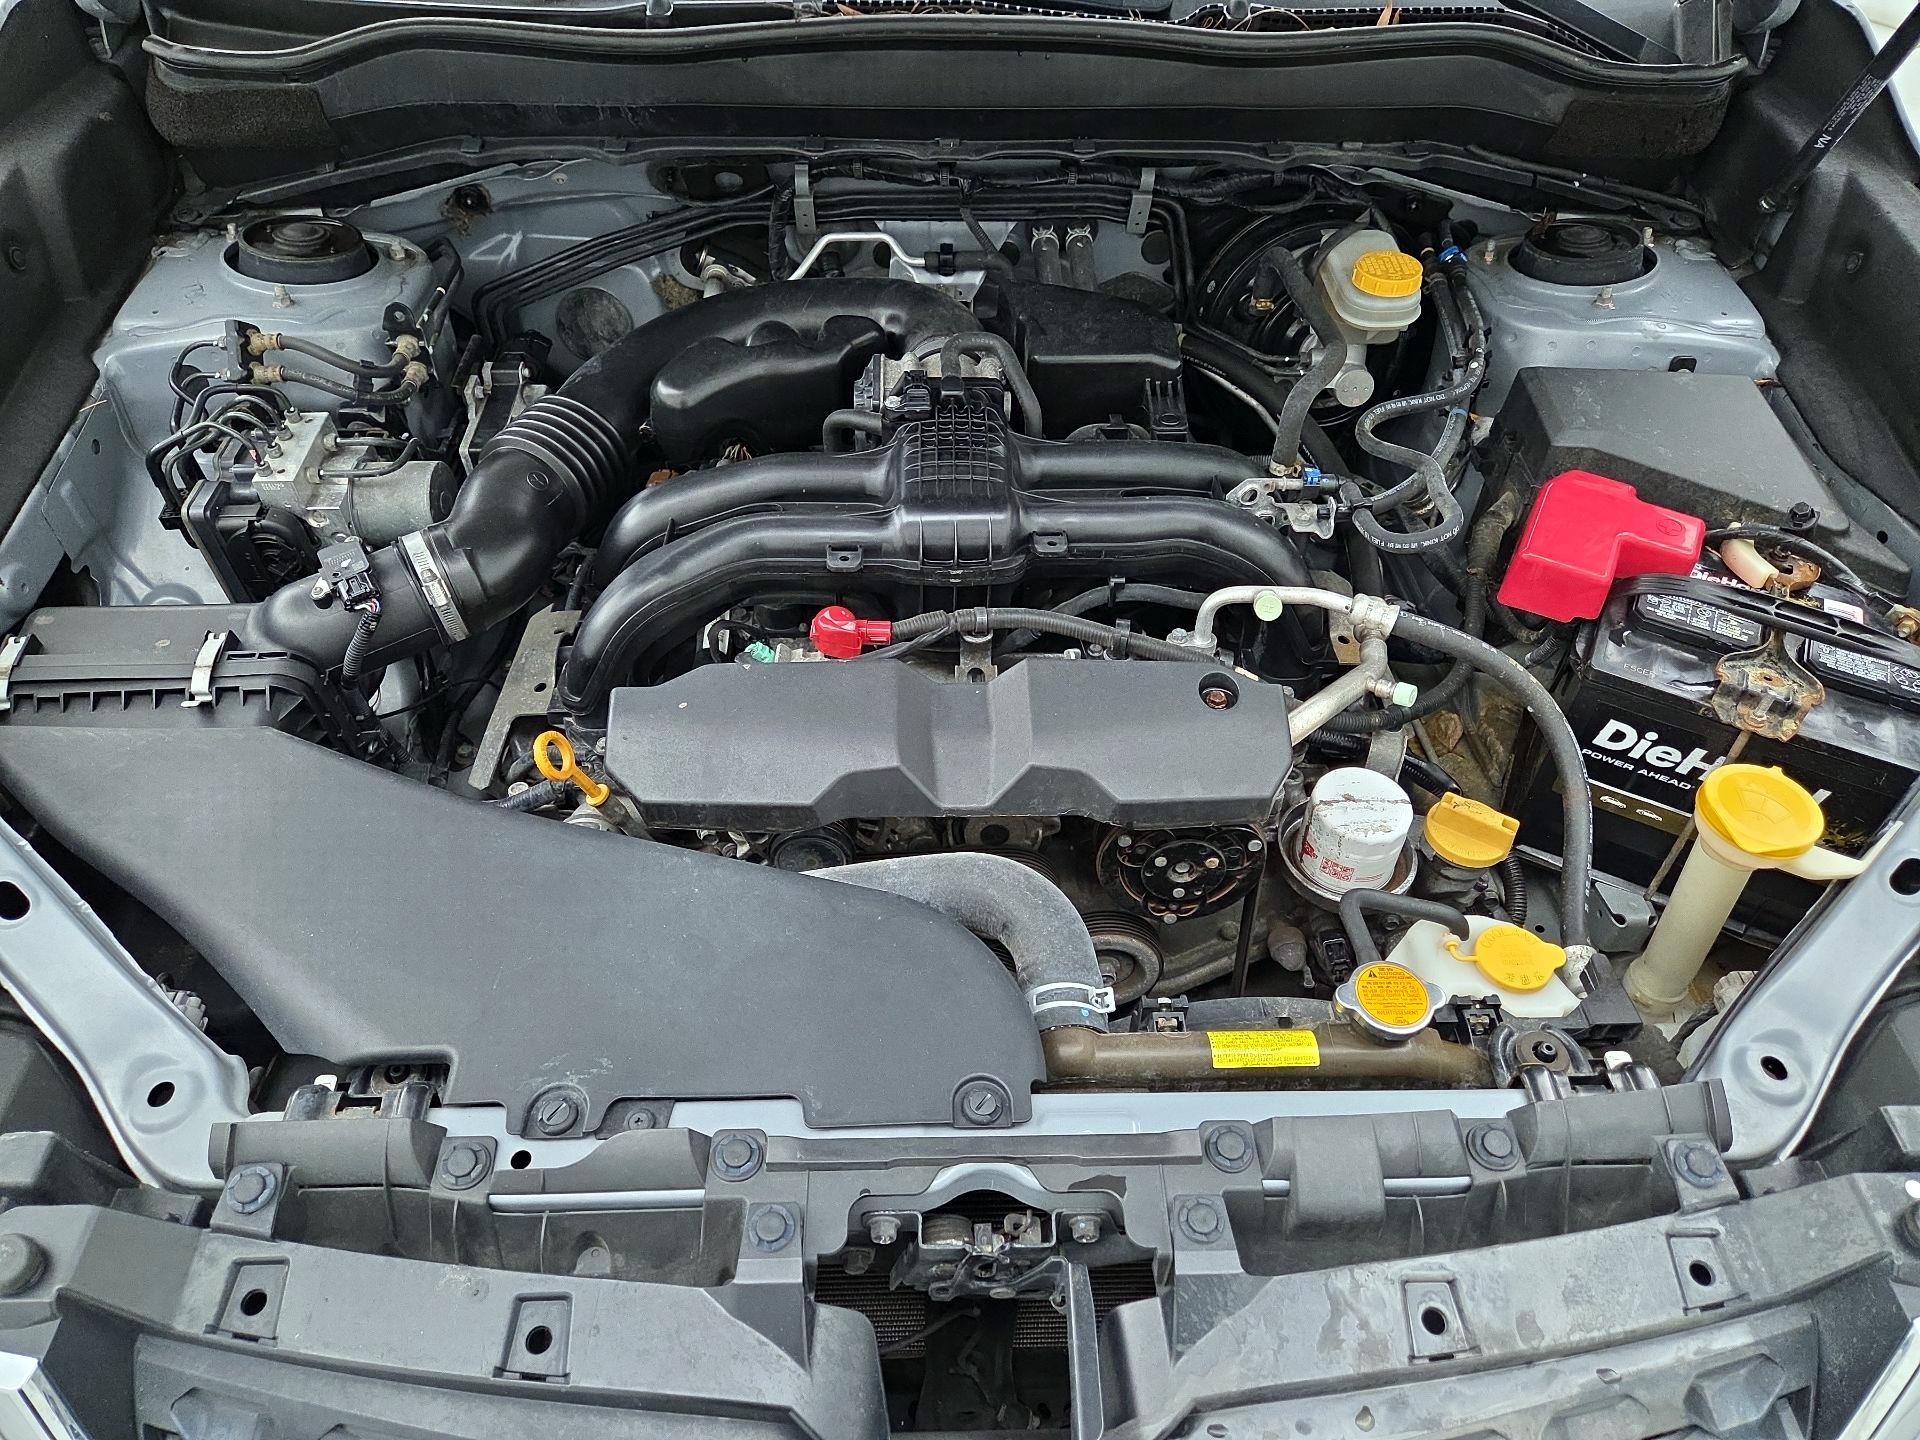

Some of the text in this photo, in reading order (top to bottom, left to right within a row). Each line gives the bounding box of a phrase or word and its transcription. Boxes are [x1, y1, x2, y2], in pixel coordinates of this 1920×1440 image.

[1423, 396, 1435, 404] NOT
[1435, 393, 1446, 401] DO
[1452, 525, 1460, 535] DO
[1439, 530, 1452, 541] NOT
[1582, 749, 1693, 790] POWER AHEAD
